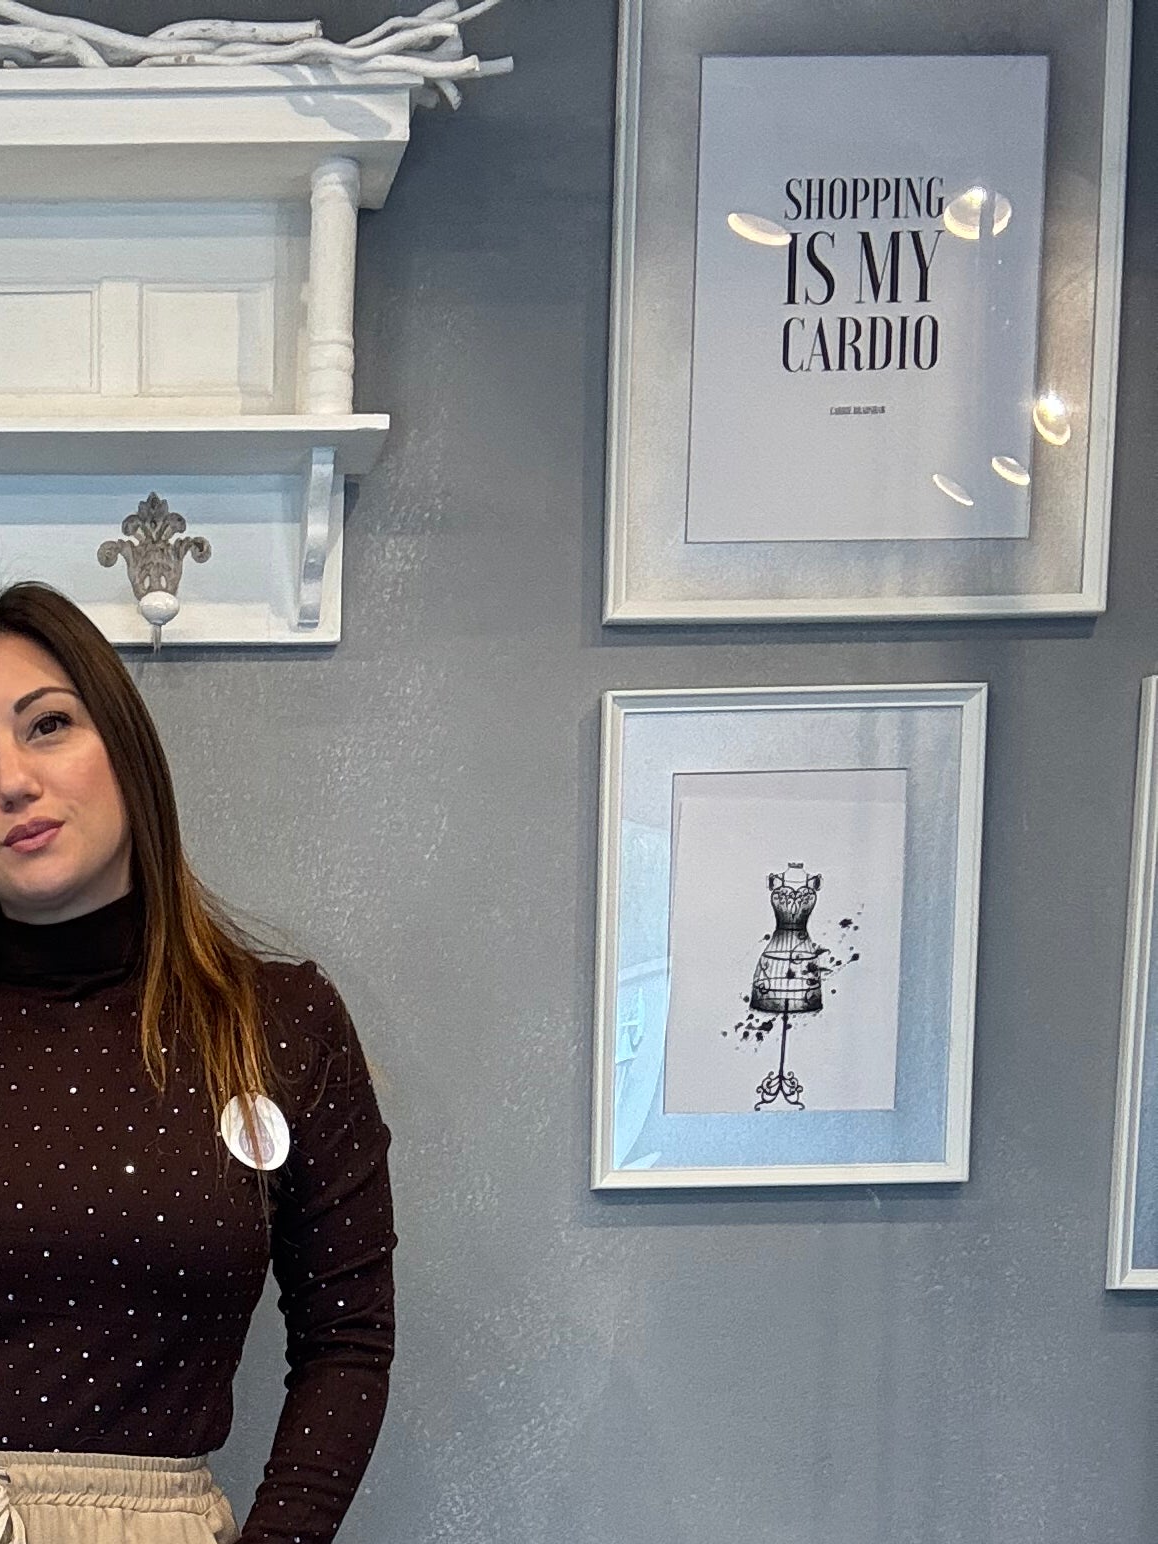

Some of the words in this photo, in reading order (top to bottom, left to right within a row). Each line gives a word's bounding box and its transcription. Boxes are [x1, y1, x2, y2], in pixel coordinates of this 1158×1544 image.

[783, 176, 945, 221] SHOPPING
[782, 230, 836, 306] IS
[855, 229, 945, 304] MY
[781, 314, 940, 373] CARDIO
